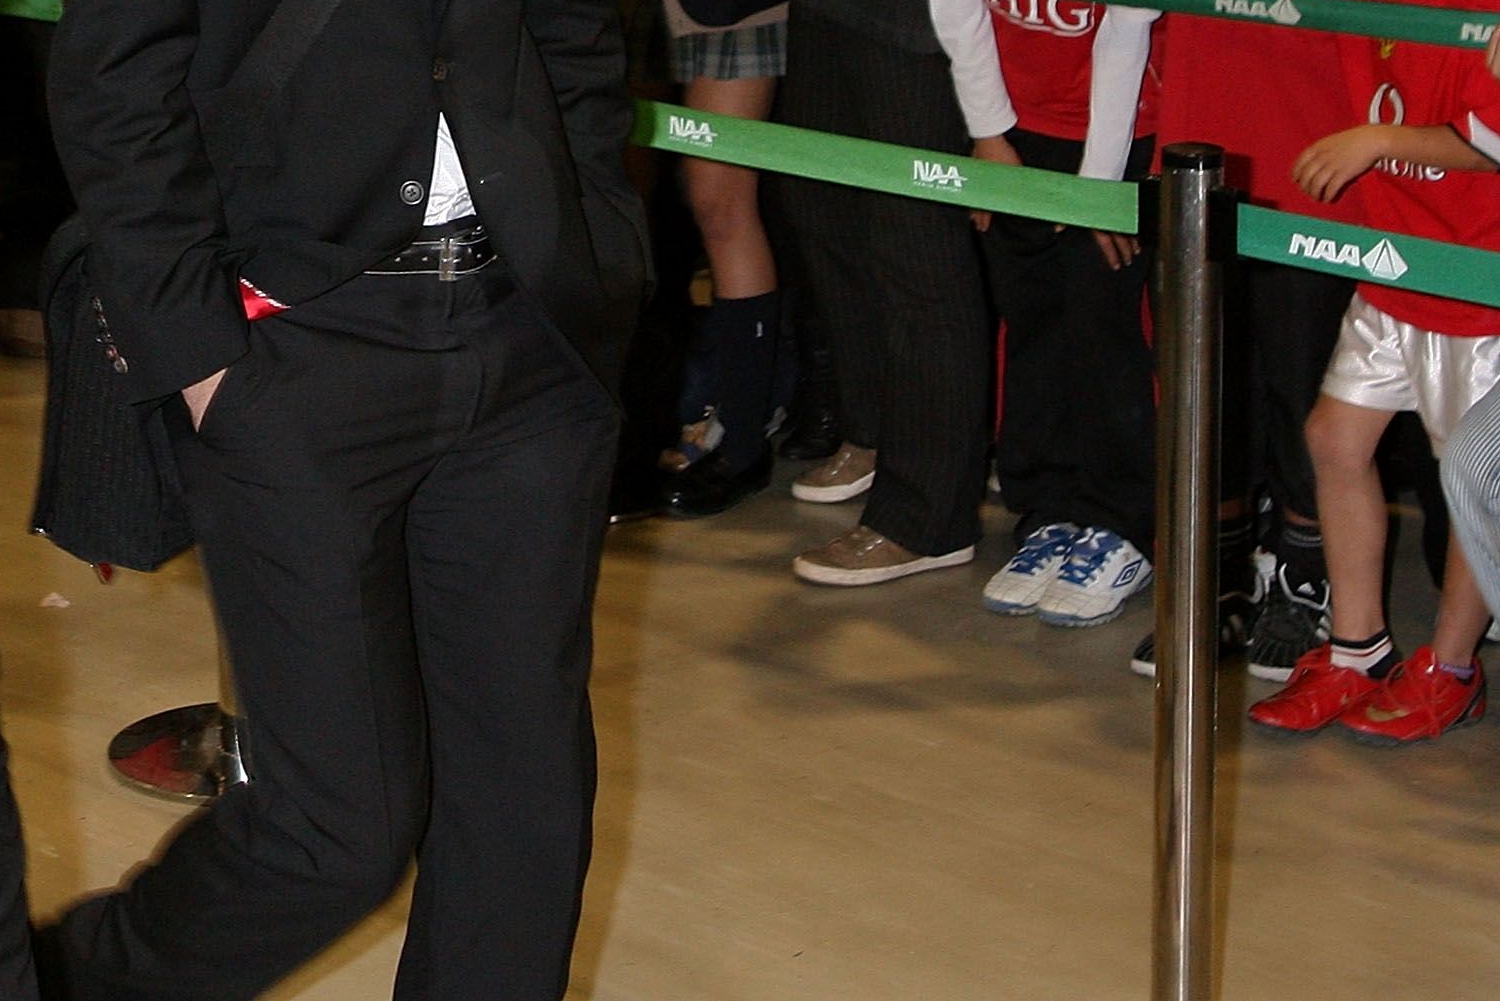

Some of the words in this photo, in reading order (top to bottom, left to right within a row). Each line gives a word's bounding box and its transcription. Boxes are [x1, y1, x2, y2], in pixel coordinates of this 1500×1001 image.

[668, 115, 717, 143] NAA
[913, 160, 967, 188] NAA
[1288, 232, 1360, 267] NAA
